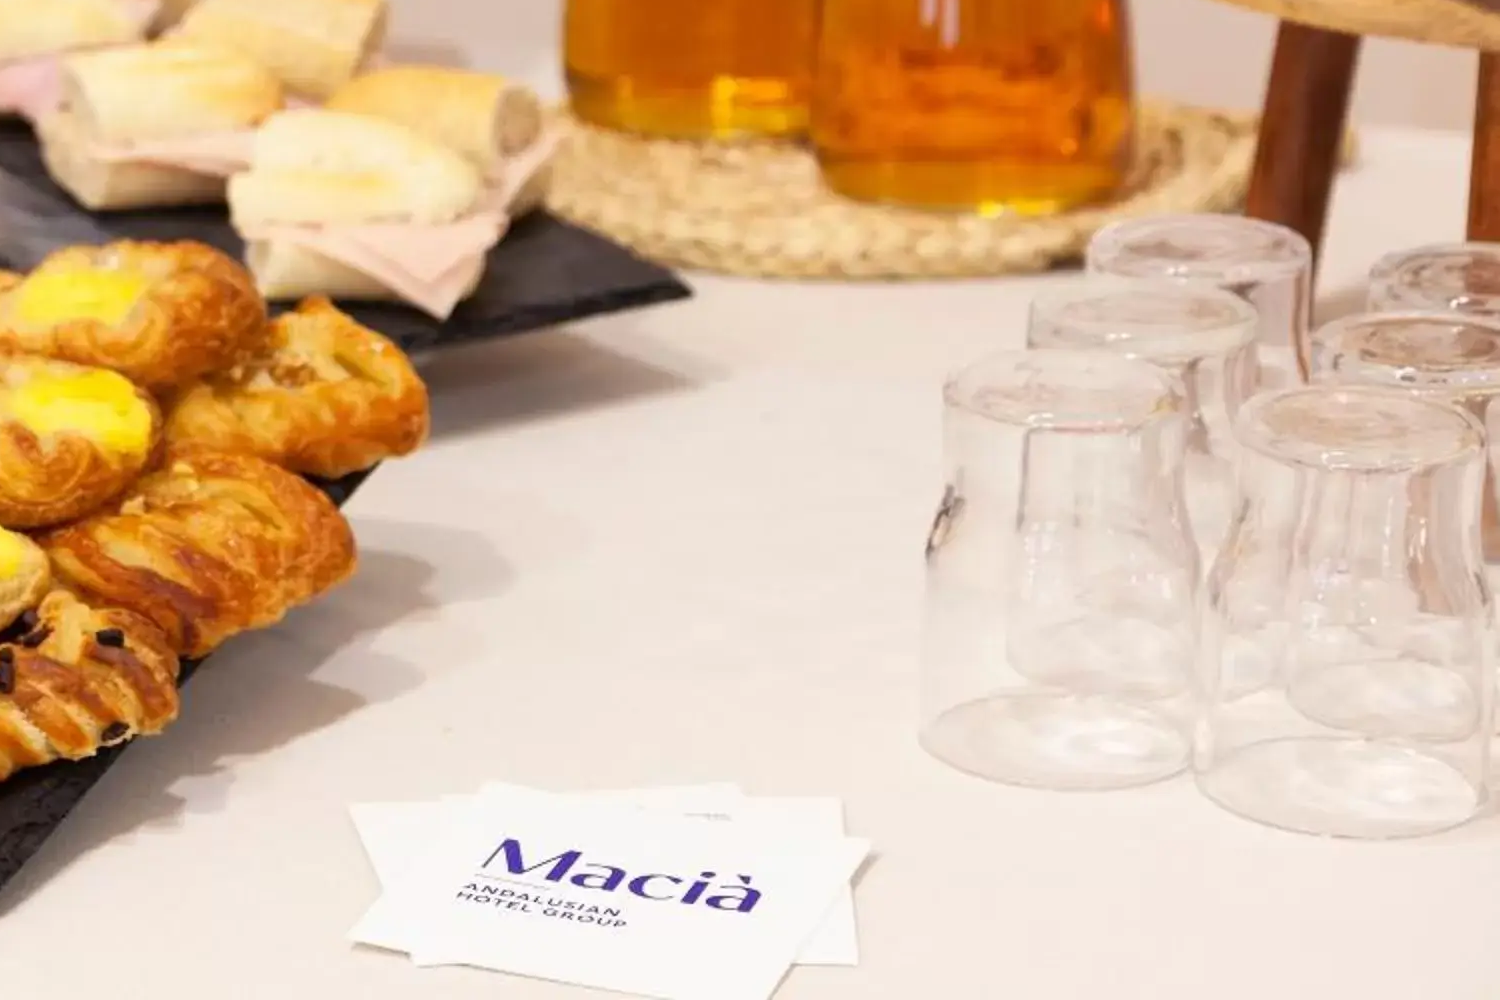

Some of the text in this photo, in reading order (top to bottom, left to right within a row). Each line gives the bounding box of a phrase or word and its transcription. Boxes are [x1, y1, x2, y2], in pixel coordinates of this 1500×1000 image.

[481, 838, 762, 914] Macià
[456, 890, 627, 927] HOTEL GROUP
[463, 882, 621, 917] ANDALUSIAN
